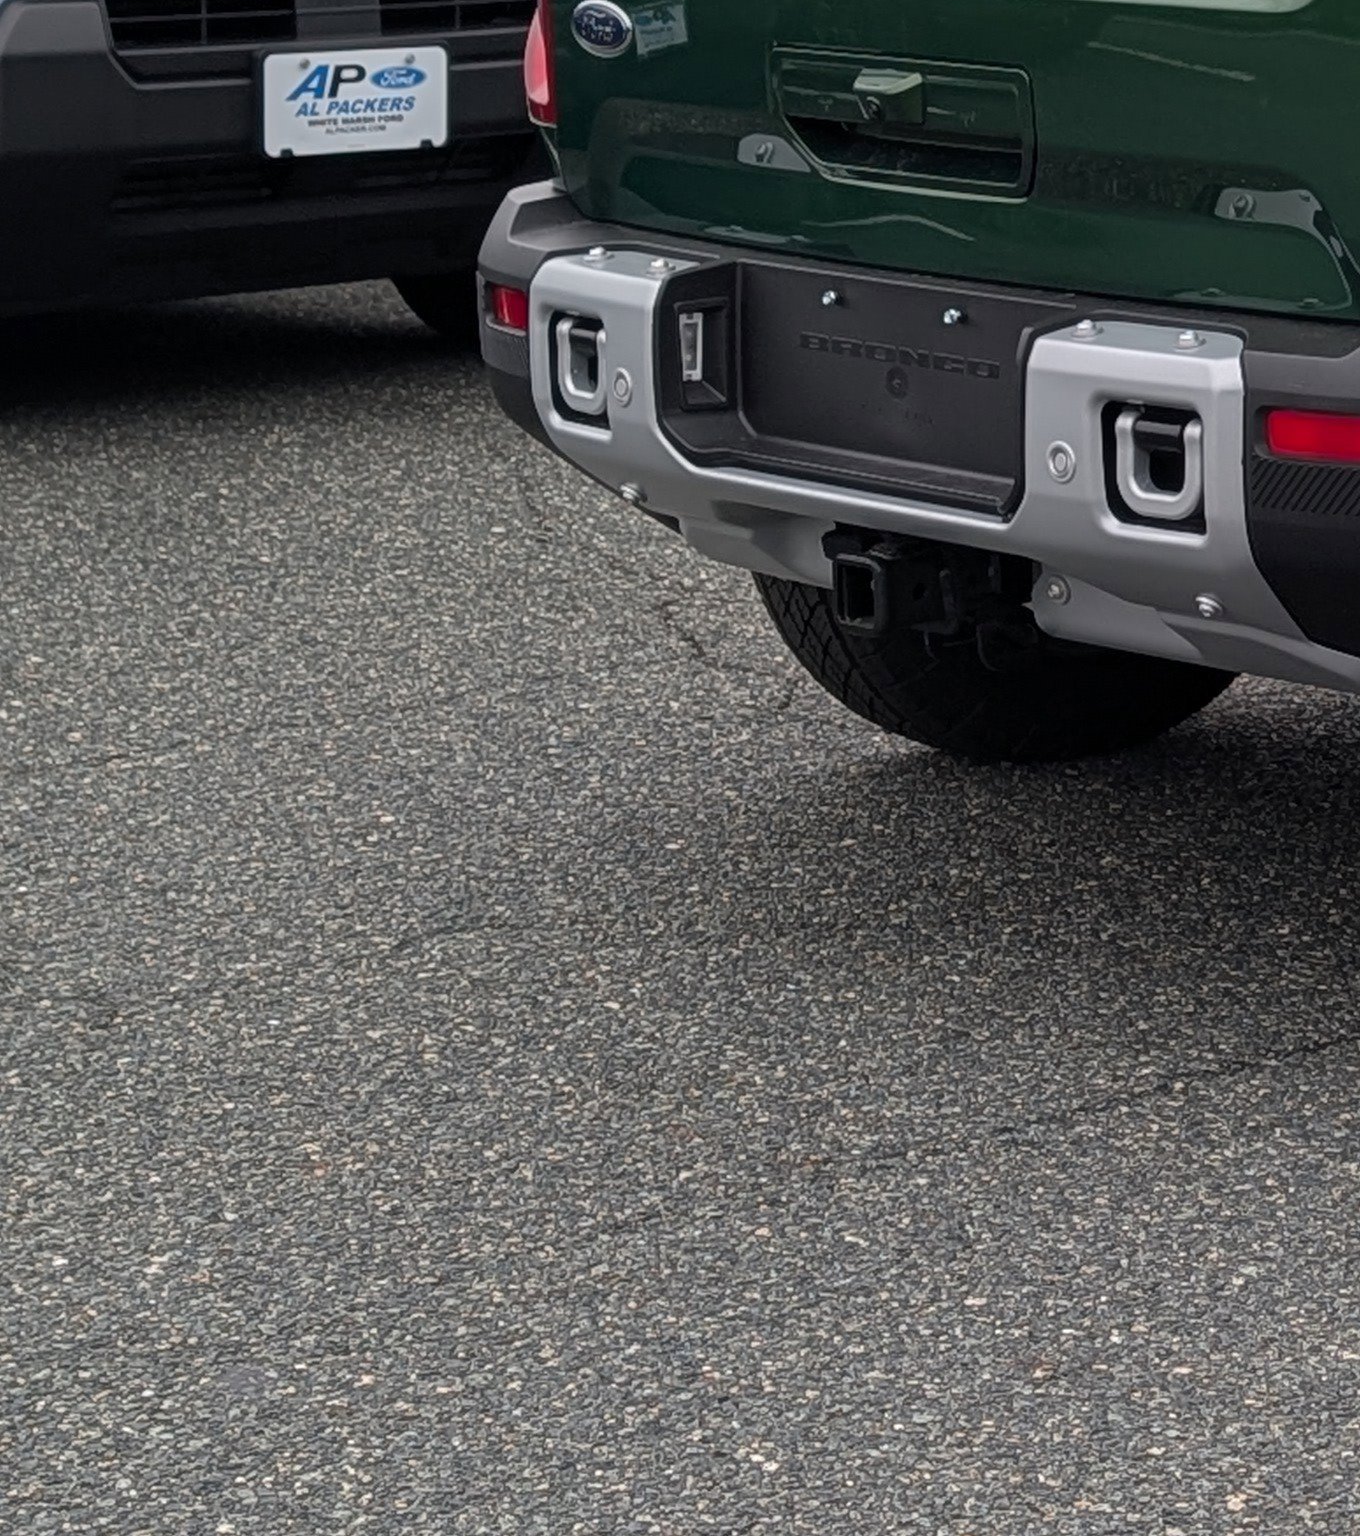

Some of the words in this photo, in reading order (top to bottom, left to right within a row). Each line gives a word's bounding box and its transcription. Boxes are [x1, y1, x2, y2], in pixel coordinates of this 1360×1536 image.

[285, 63, 367, 102] AP
[379, 68, 416, 86] Ford
[294, 101, 320, 118] AL
[325, 95, 417, 116] PACKERS
[307, 117, 338, 127] WHITE
[377, 113, 404, 123] FORD
[799, 330, 1000, 380] BRONCO
